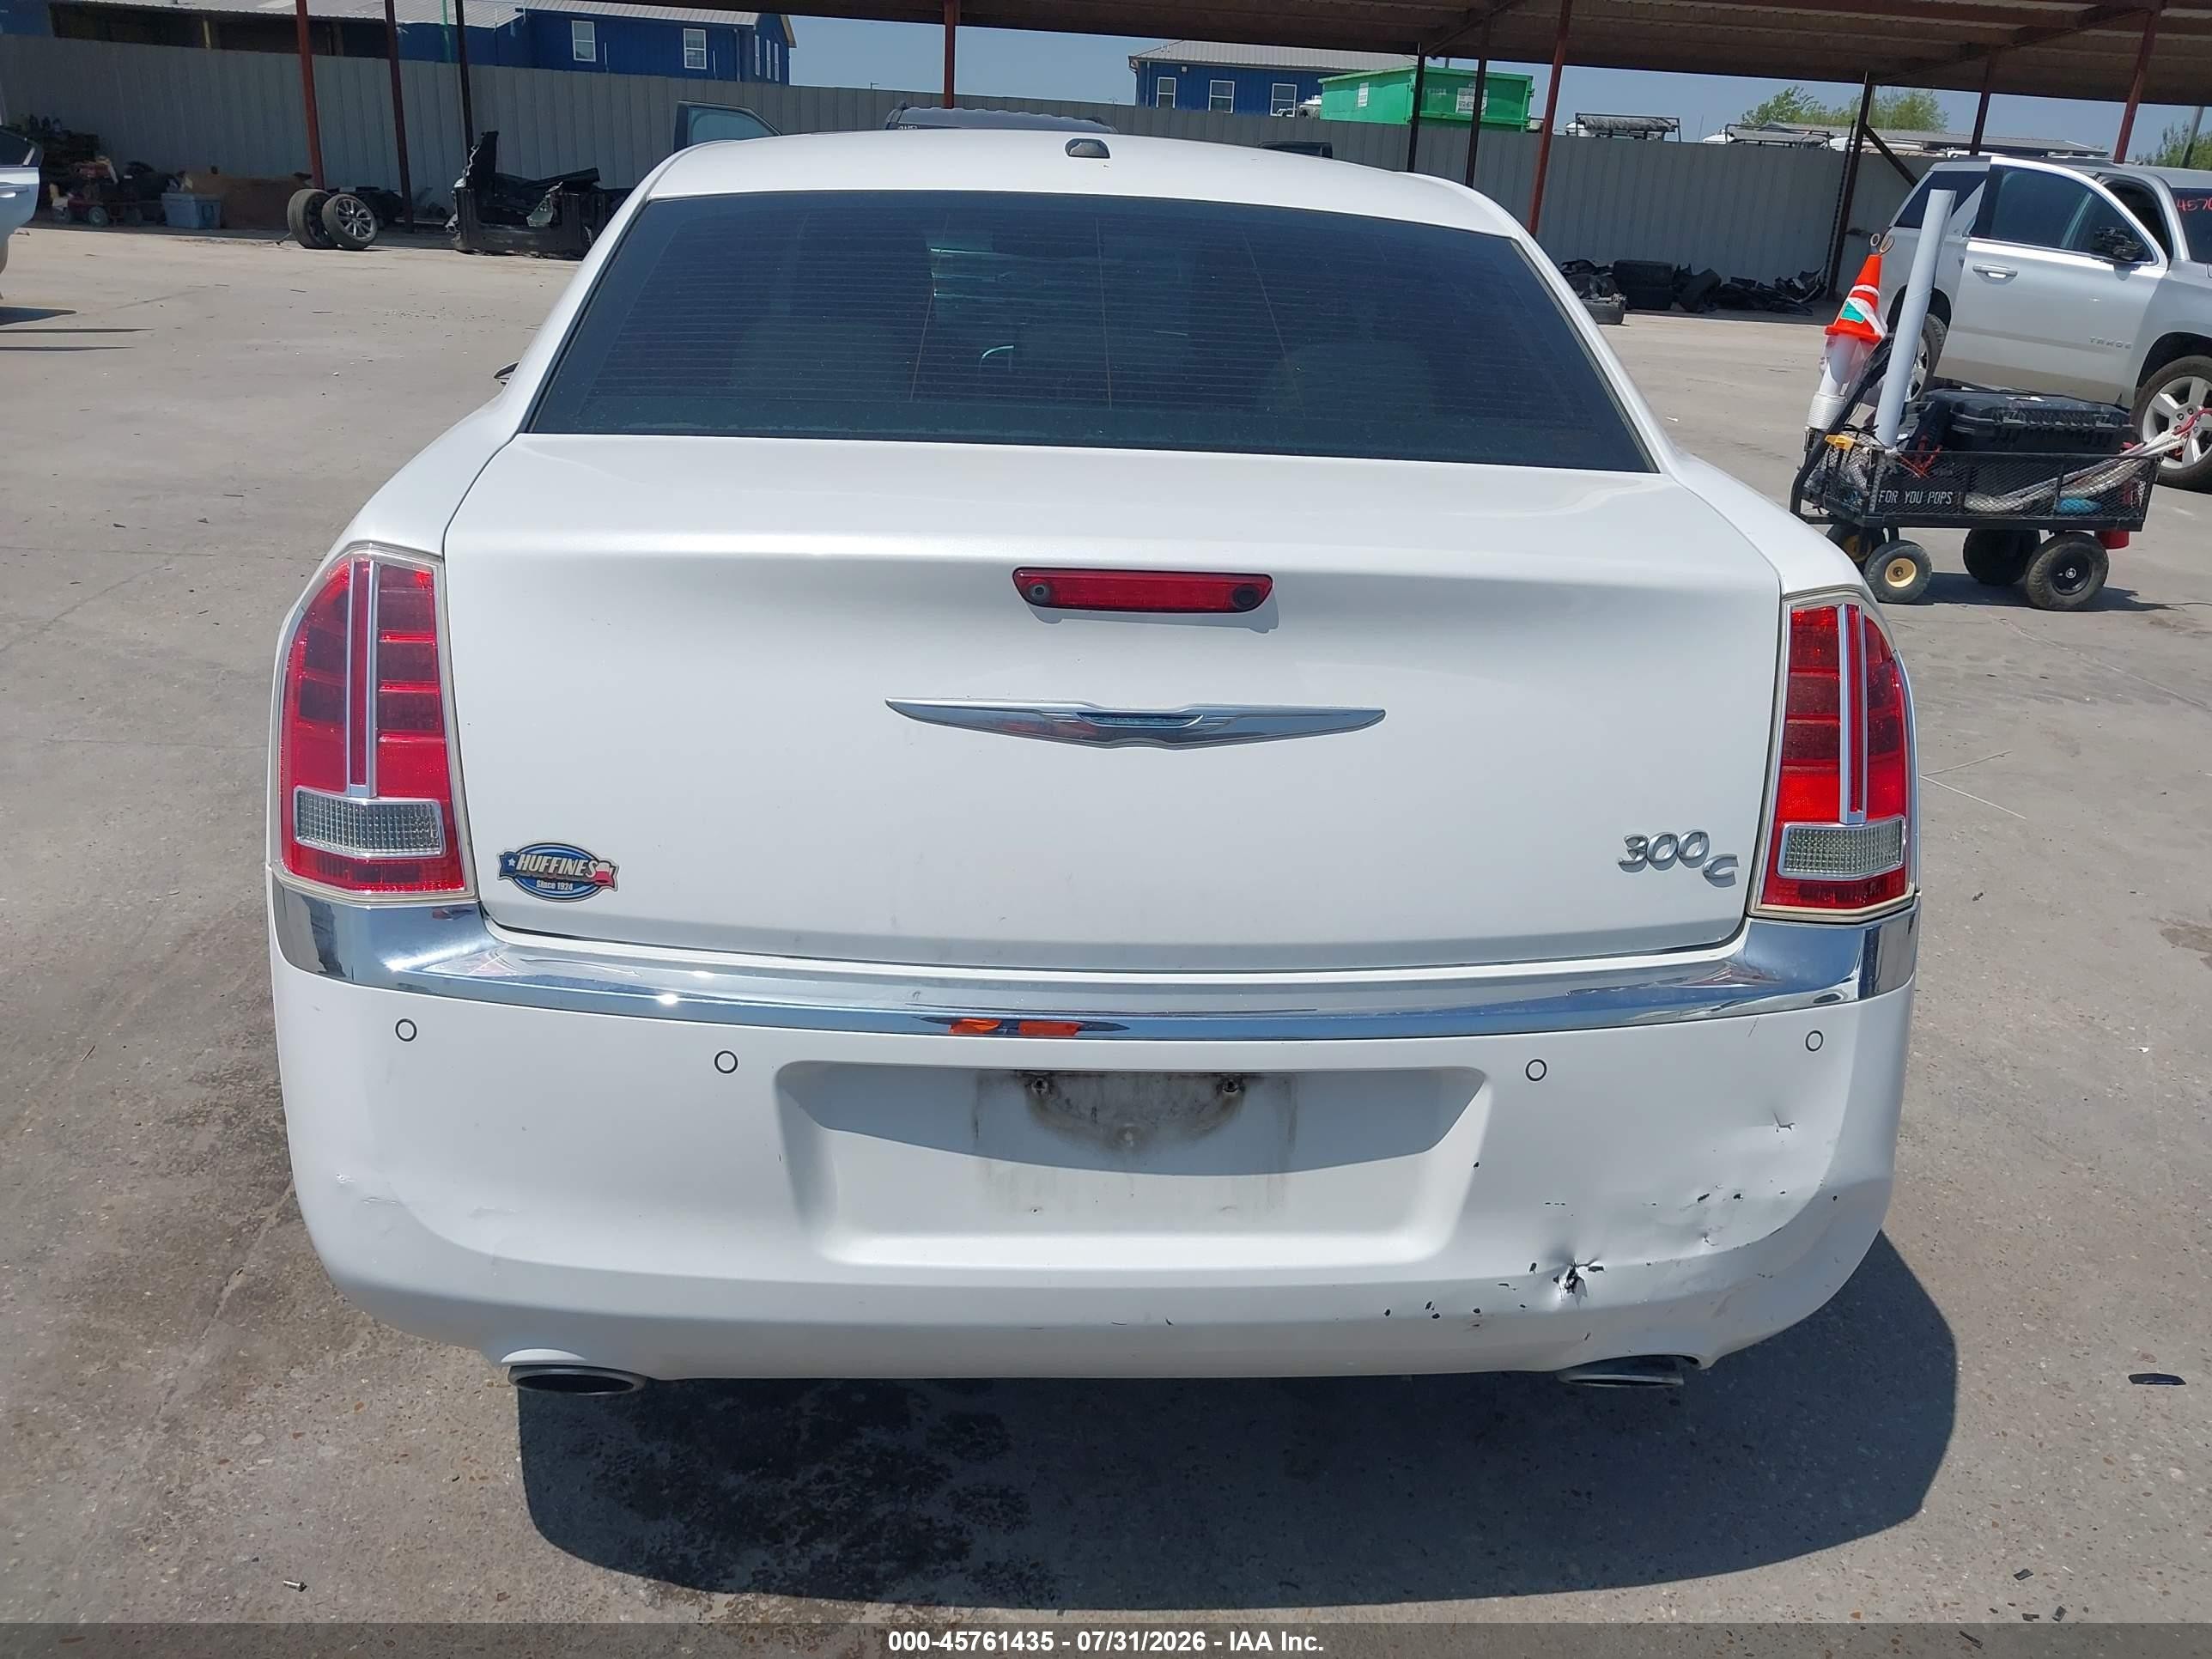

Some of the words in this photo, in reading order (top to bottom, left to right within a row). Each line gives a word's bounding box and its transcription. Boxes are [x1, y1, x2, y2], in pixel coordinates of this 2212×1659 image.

[1878, 489, 1899, 504] FOR
[1904, 490, 1923, 504] YOU
[1927, 491, 1954, 505] POPS
[515, 853, 599, 878] HUFFINES
[536, 879, 556, 890] Since
[556, 882, 574, 891] 1924
